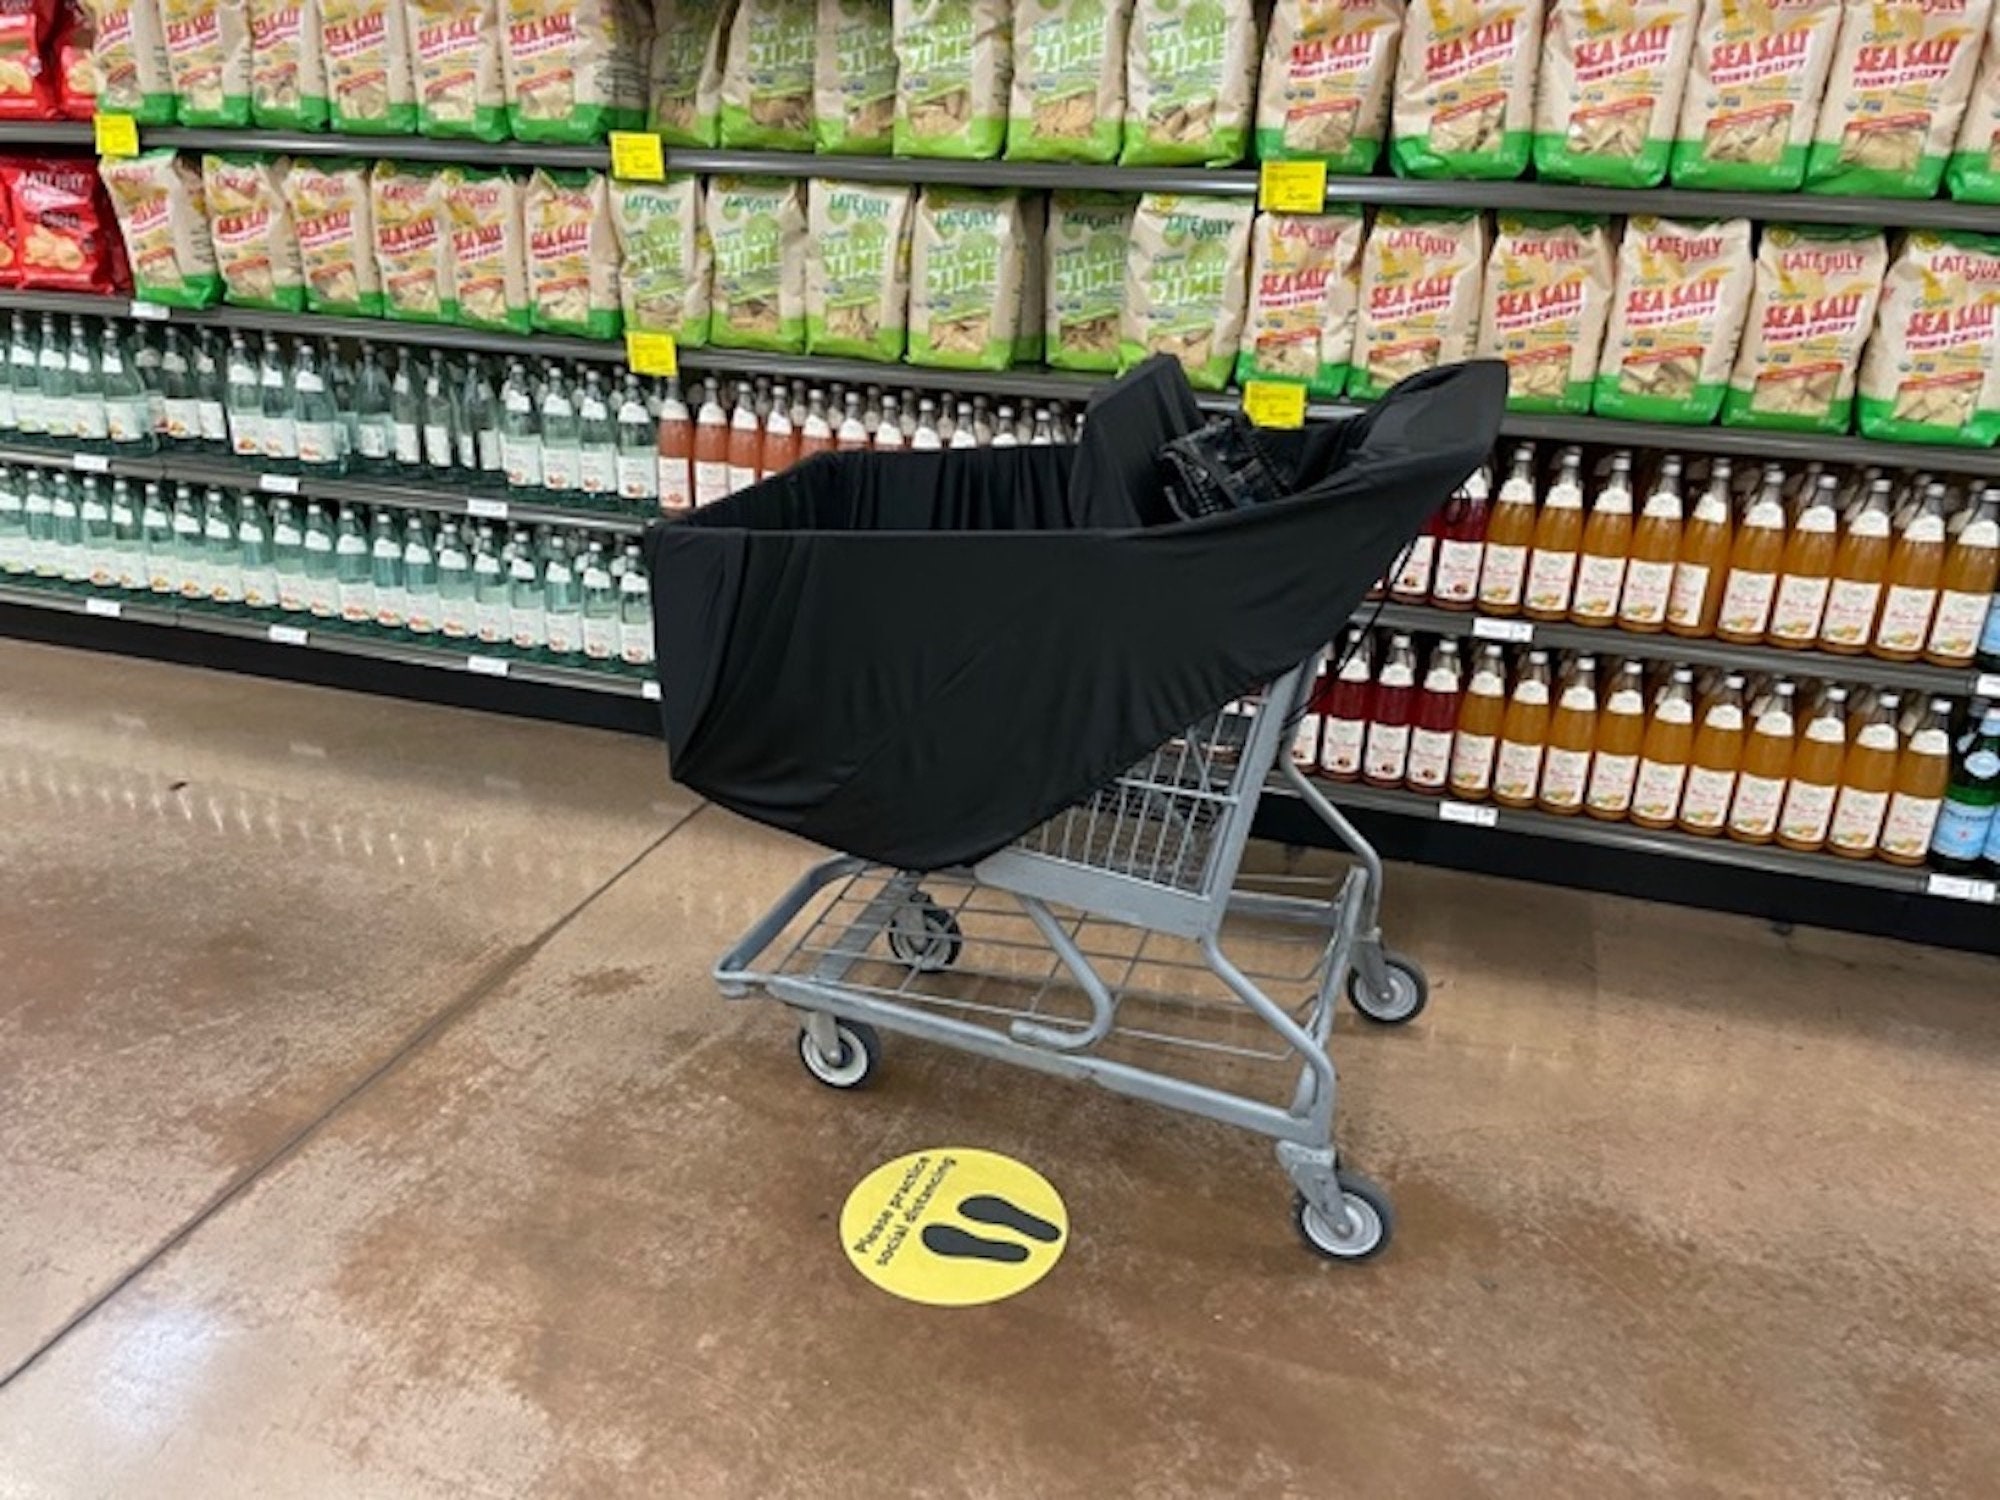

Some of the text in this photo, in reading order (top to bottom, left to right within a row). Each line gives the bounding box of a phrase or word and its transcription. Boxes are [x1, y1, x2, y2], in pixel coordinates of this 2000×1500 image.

[1426, 18, 1516, 70] SEA SALT
[1575, 25, 1674, 69] SEA SALT
[1709, 28, 1812, 72] SEA SALT
[1853, 38, 1960, 73] SEA SALT
[1646, 237, 1724, 263] LATE JULY
[1782, 252, 1866, 276] LATE JULY
[1931, 255, 1973, 274] LATE
[1371, 275, 1454, 310] SEA SALT
[1496, 279, 1584, 318] SEA SALT
[1626, 278, 1722, 314] SEA SALT
[1763, 293, 1863, 329] SEA SALT
[1905, 303, 1996, 338] SEA SALT
[854, 1156, 930, 1253] Please practice
[876, 1157, 957, 1265] social distancing
